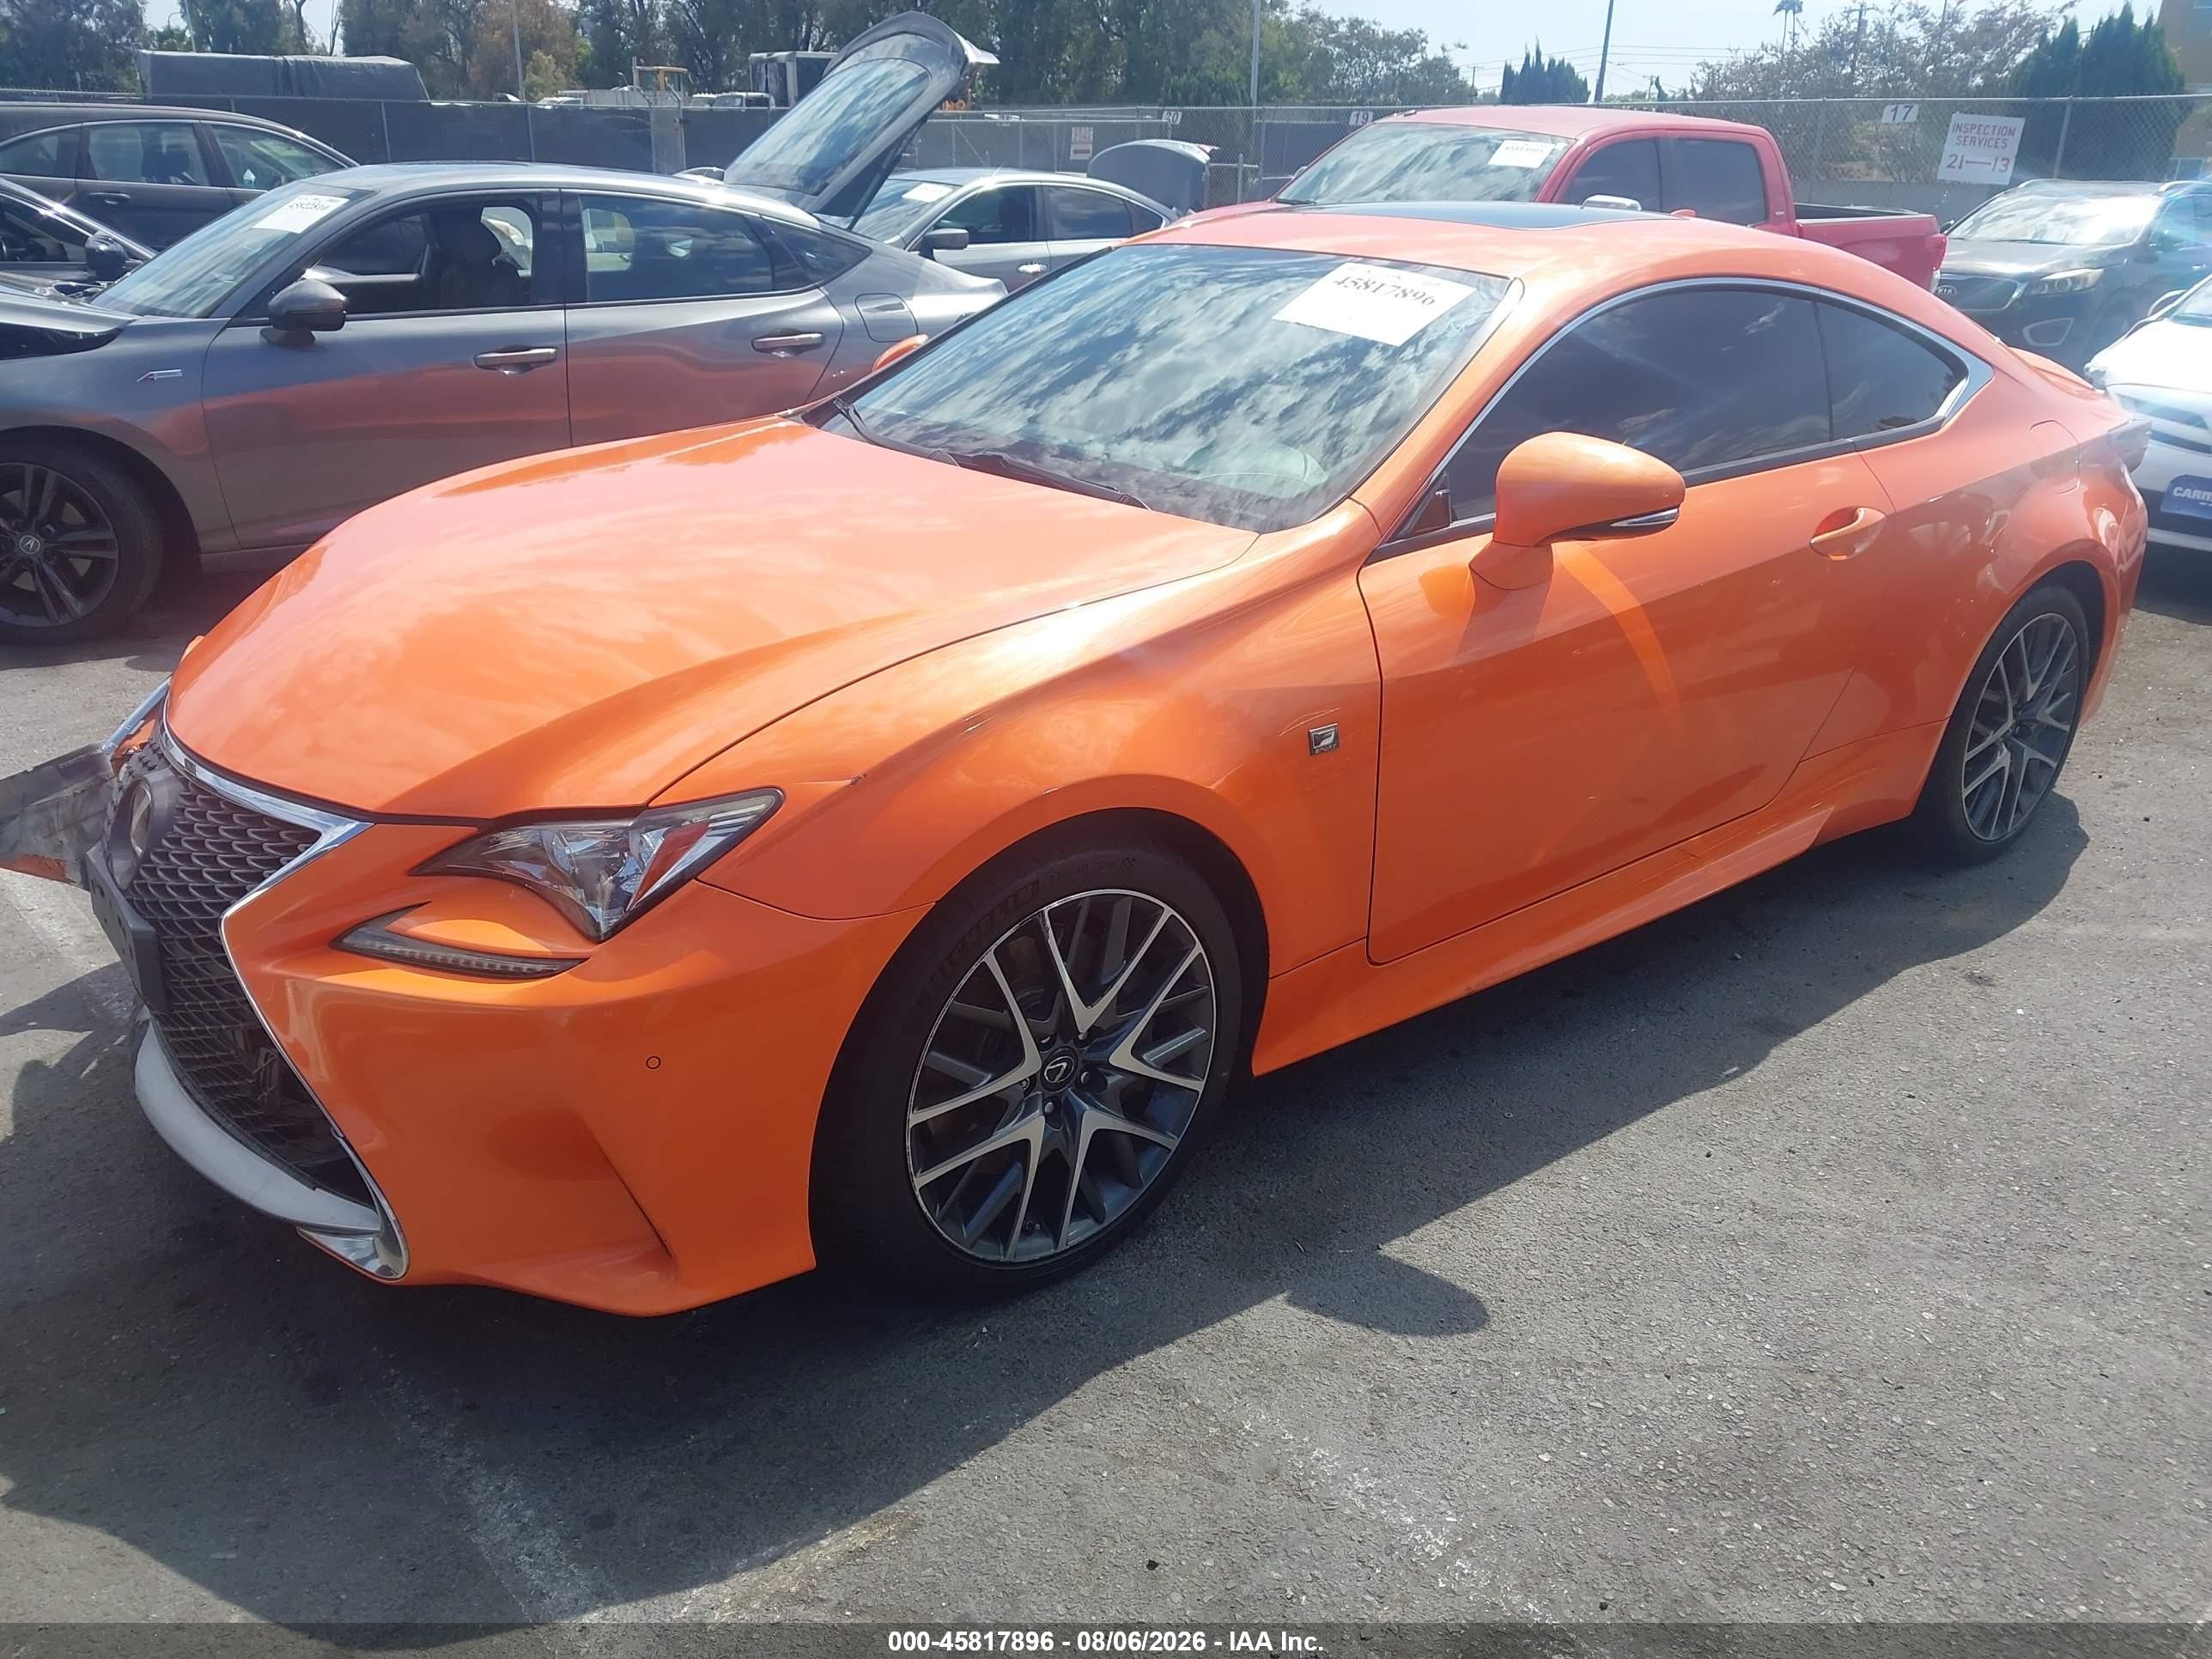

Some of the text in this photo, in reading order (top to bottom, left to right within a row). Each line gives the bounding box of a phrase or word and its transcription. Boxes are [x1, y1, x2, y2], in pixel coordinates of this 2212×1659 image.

[1353, 112, 1370, 125] 19
[1890, 104, 1914, 122] 17
[1951, 122, 2017, 137] INSPECTION
[1955, 135, 2008, 150] SERVICES
[1333, 275, 1437, 306] 45817896
